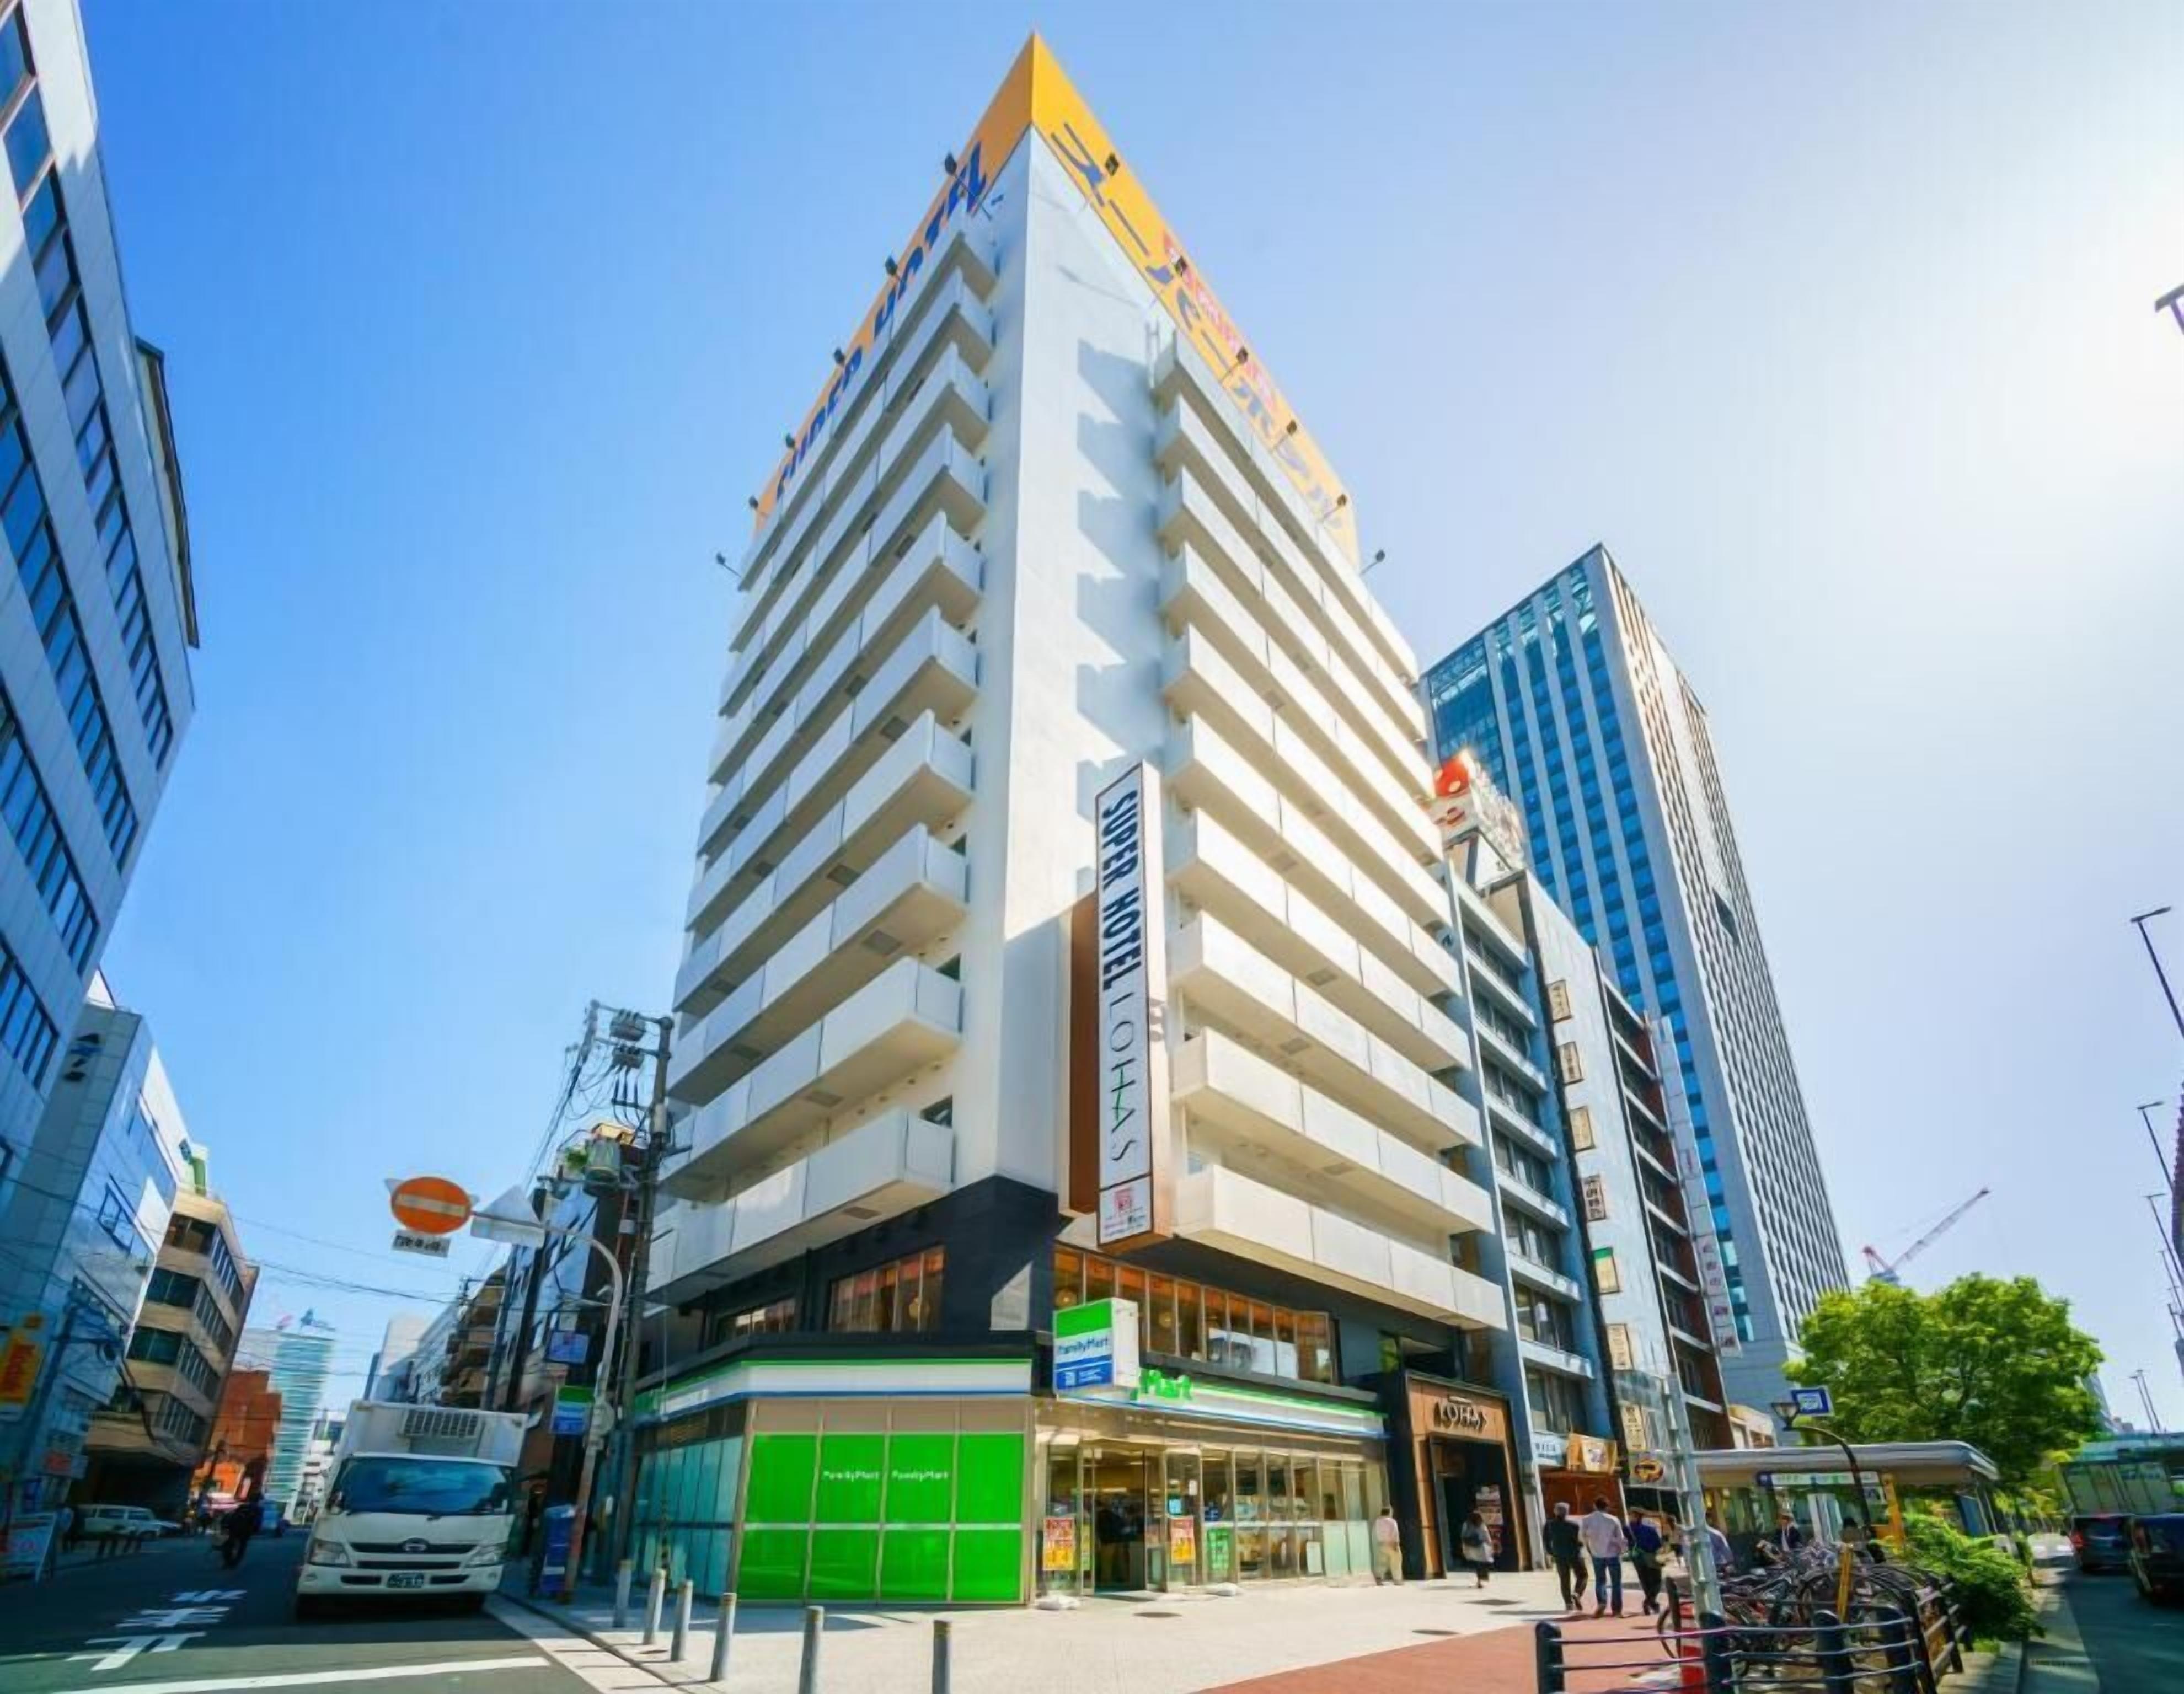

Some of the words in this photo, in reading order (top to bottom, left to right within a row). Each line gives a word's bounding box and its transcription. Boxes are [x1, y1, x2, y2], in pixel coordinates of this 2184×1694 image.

[1101, 789, 1138, 892] SUPER
[1102, 886, 1142, 991] HOTEL
[1110, 991, 1137, 1161] LOHAS
